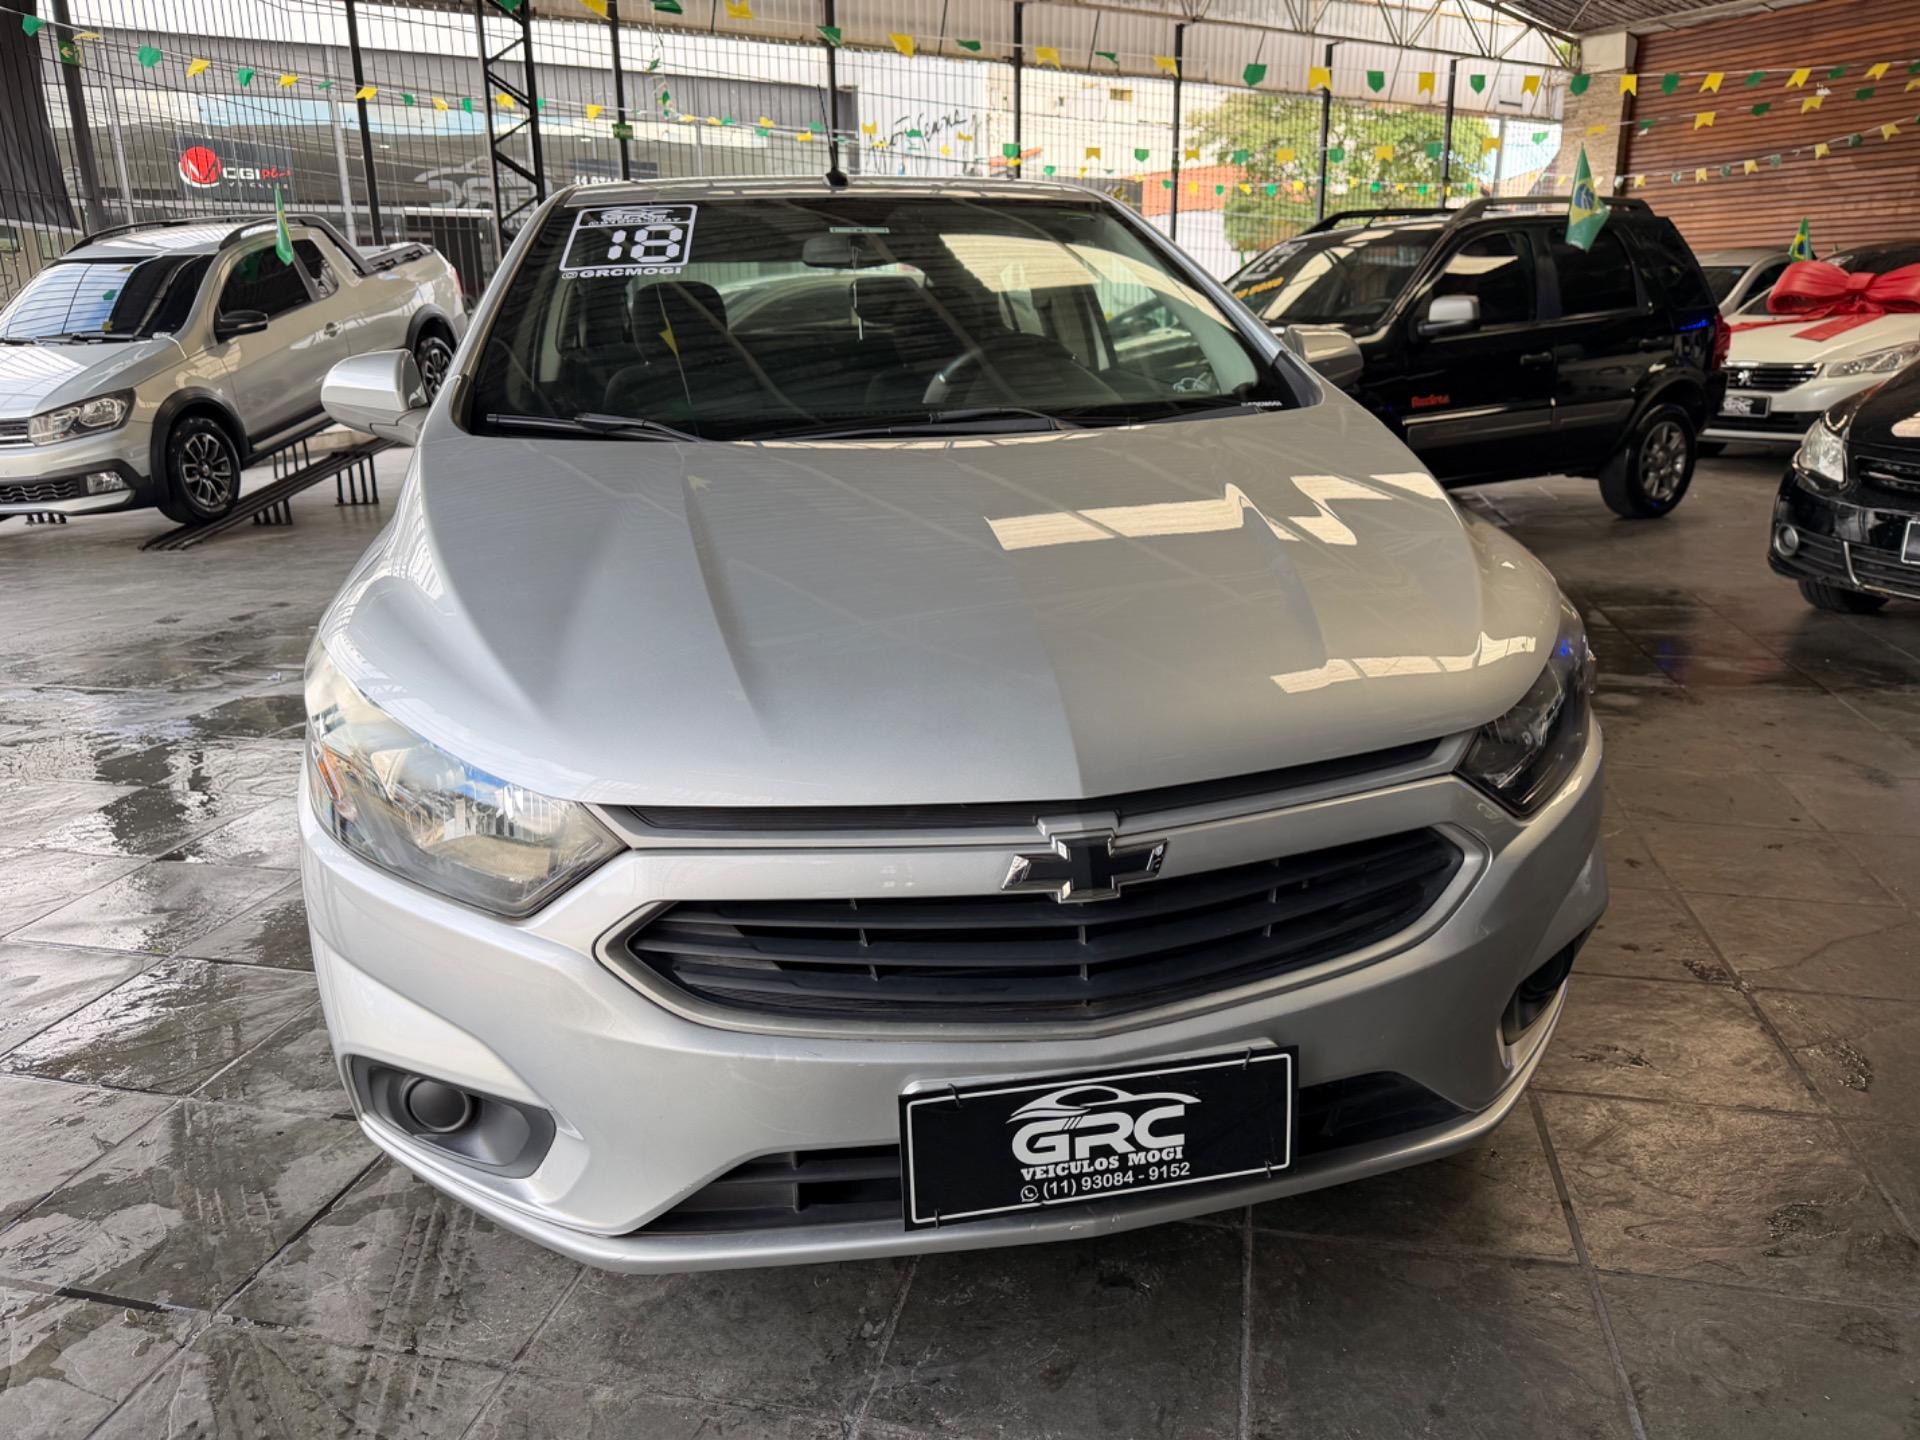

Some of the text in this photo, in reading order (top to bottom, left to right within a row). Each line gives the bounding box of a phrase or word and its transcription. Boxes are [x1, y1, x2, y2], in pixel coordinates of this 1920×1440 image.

[607, 224, 683, 263] 18
[580, 267, 683, 278] GRCMOGI
[1011, 1104, 1186, 1165] GRC
[1020, 1146, 1184, 1181] VEICULOS MOGI
[1042, 1179, 1077, 1198] (11)
[1081, 1171, 1135, 1191] 93084
[1148, 1162, 1191, 1181] 9152
